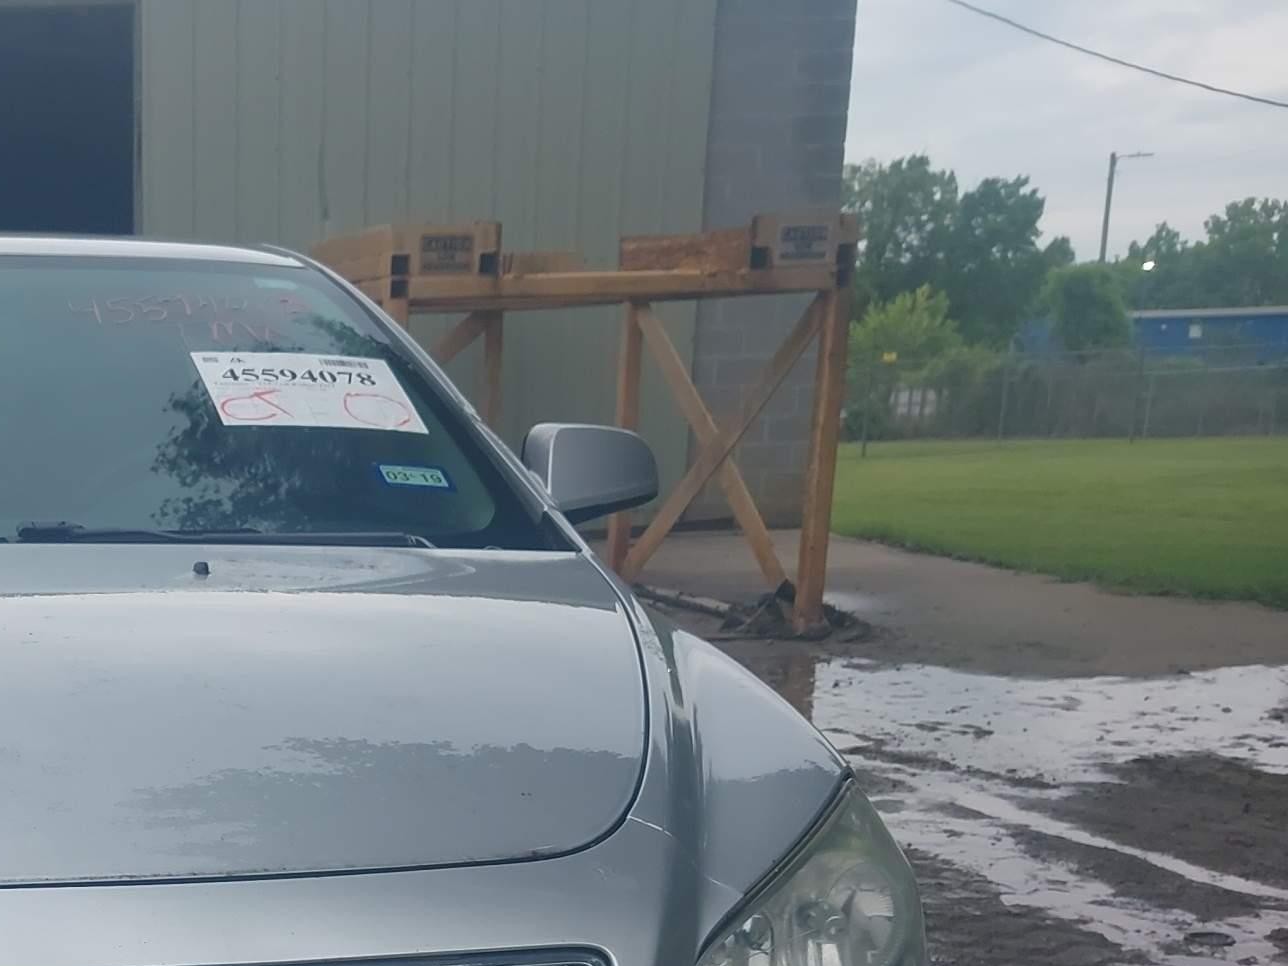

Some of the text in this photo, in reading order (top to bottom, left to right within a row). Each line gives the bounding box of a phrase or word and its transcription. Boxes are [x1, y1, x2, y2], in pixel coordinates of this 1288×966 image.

[221, 367, 377, 386] 45594078
[385, 470, 443, 484] 03 19
